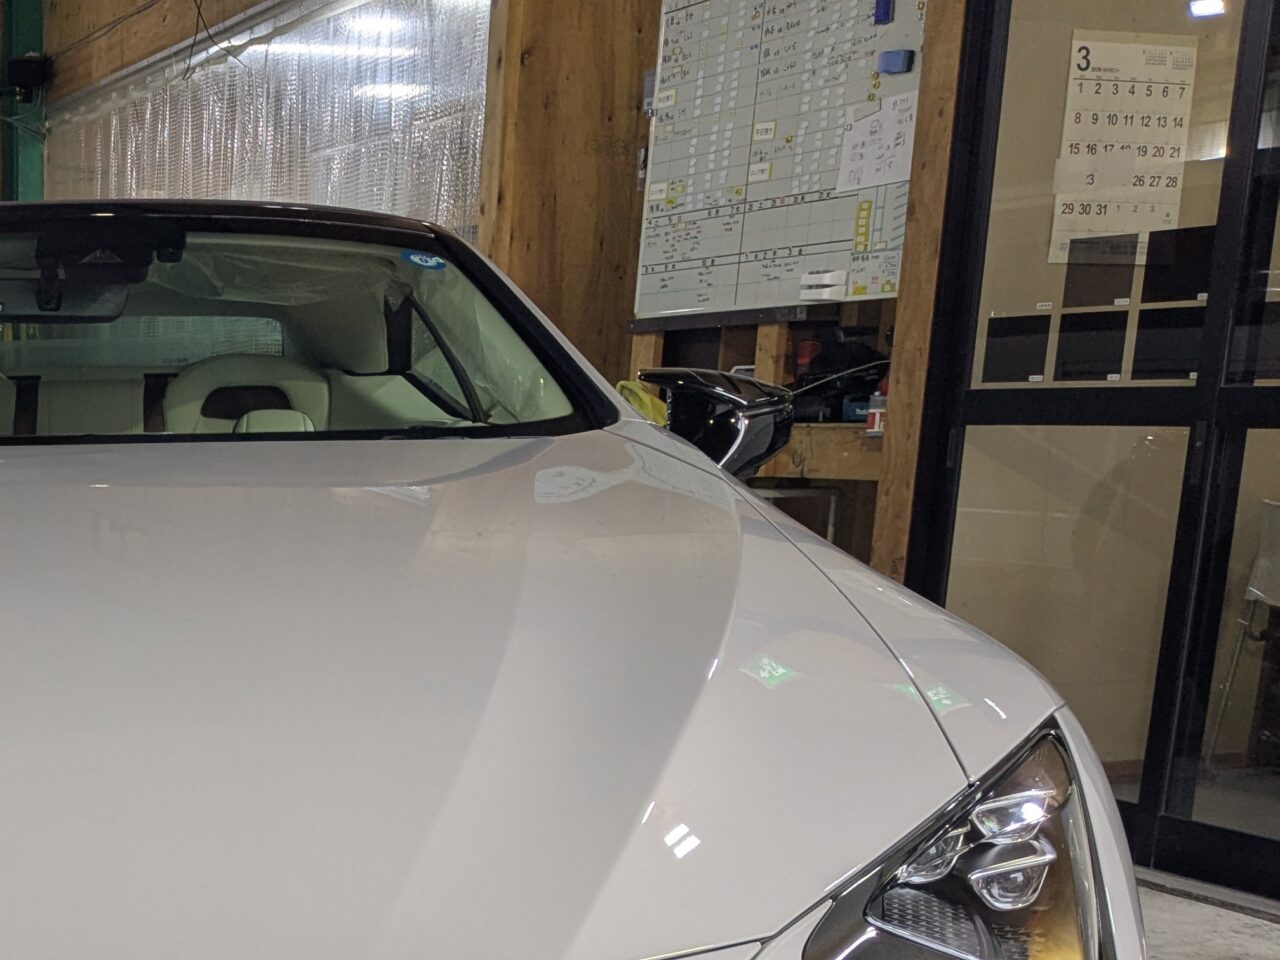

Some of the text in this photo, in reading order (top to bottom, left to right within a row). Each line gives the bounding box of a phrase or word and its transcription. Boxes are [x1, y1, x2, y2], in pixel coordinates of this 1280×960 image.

[1076, 45, 1091, 71] 3
[1078, 81, 1186, 99] 1 2 3 4 5 6 7
[1074, 112, 1183, 128] 8 9 10 11 12 13 14
[1068, 142, 1080, 155] 15
[1085, 143, 1097, 155] 16
[1136, 145, 1148, 157] 19
[1152, 146, 1165, 158] 20
[1169, 146, 1181, 158] 21
[1132, 175, 1145, 187] 26
[1149, 175, 1162, 187] 27
[1165, 176, 1178, 188] 28
[1061, 203, 1074, 215] 29
[1078, 203, 1091, 215] 30
[1095, 204, 1108, 215] 31
